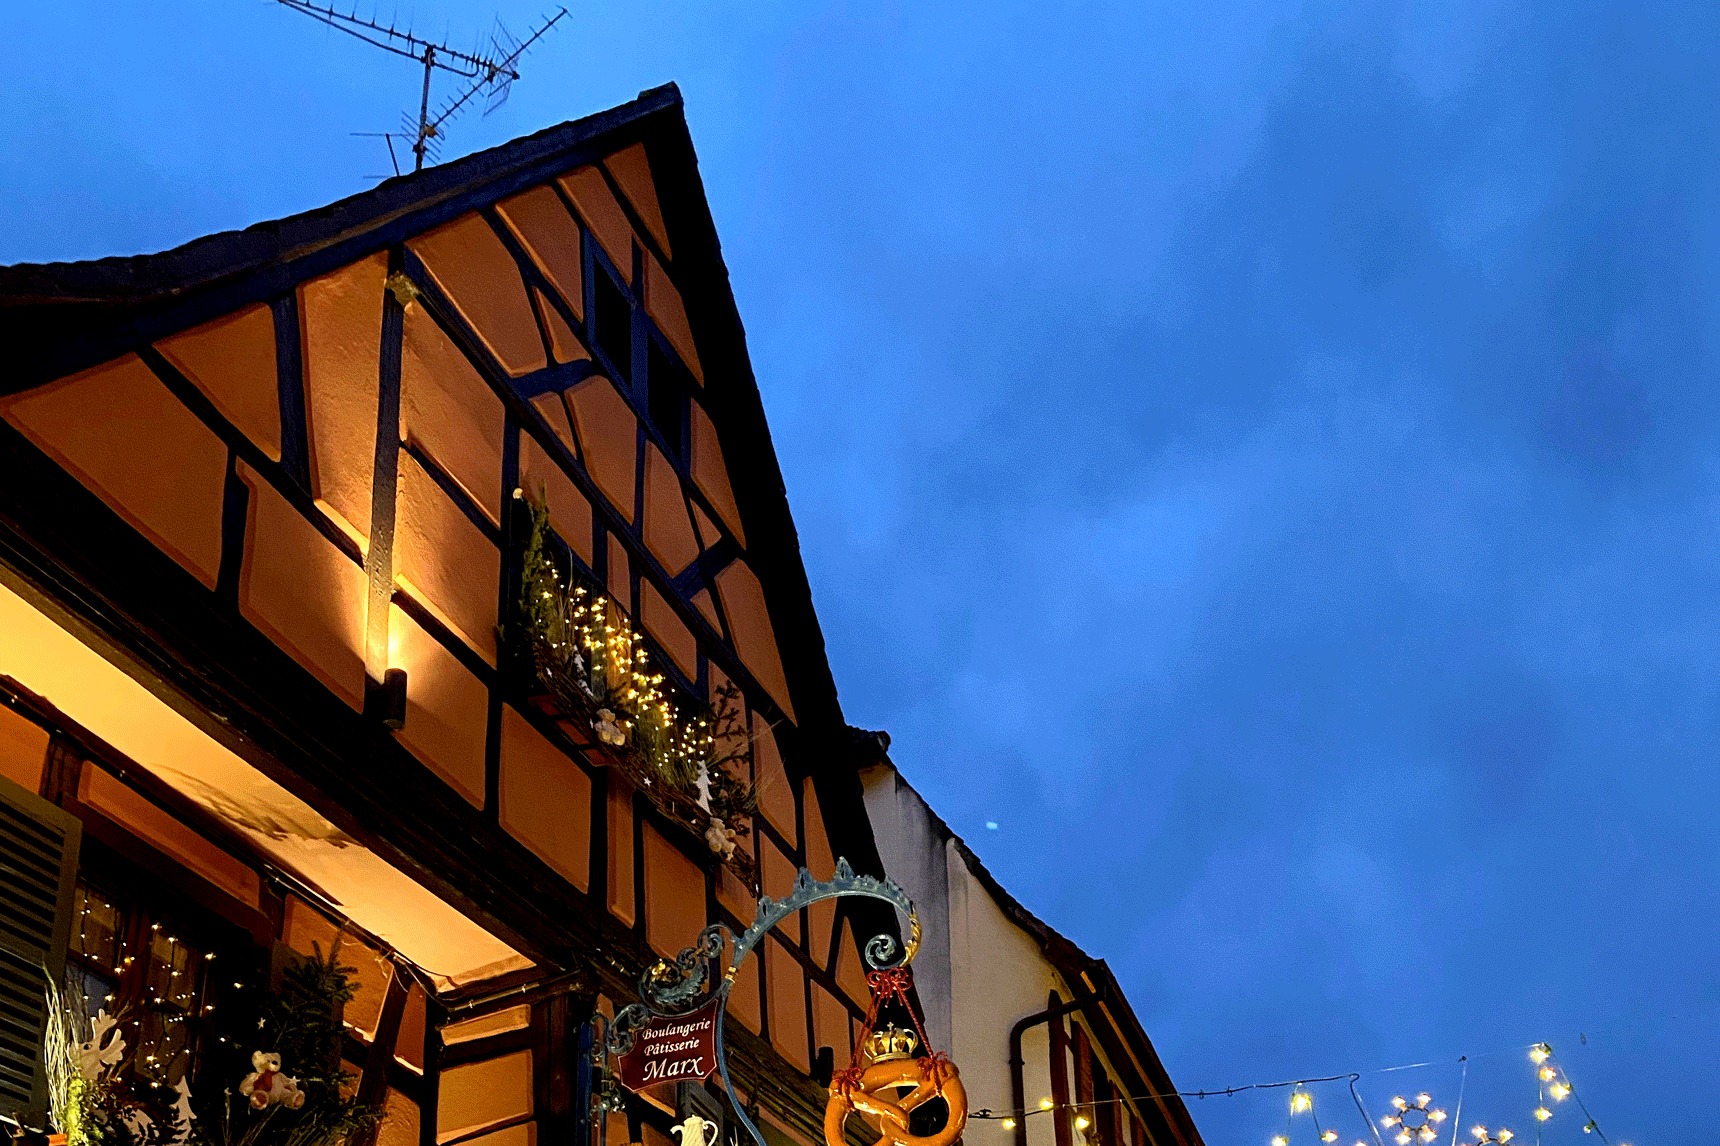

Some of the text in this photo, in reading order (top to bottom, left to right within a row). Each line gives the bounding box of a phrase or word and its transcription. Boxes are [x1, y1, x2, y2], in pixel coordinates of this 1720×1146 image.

[642, 1018, 711, 1040] Boulangerie
[643, 1036, 700, 1056] Pâtisserie
[642, 1056, 705, 1081] Marx
